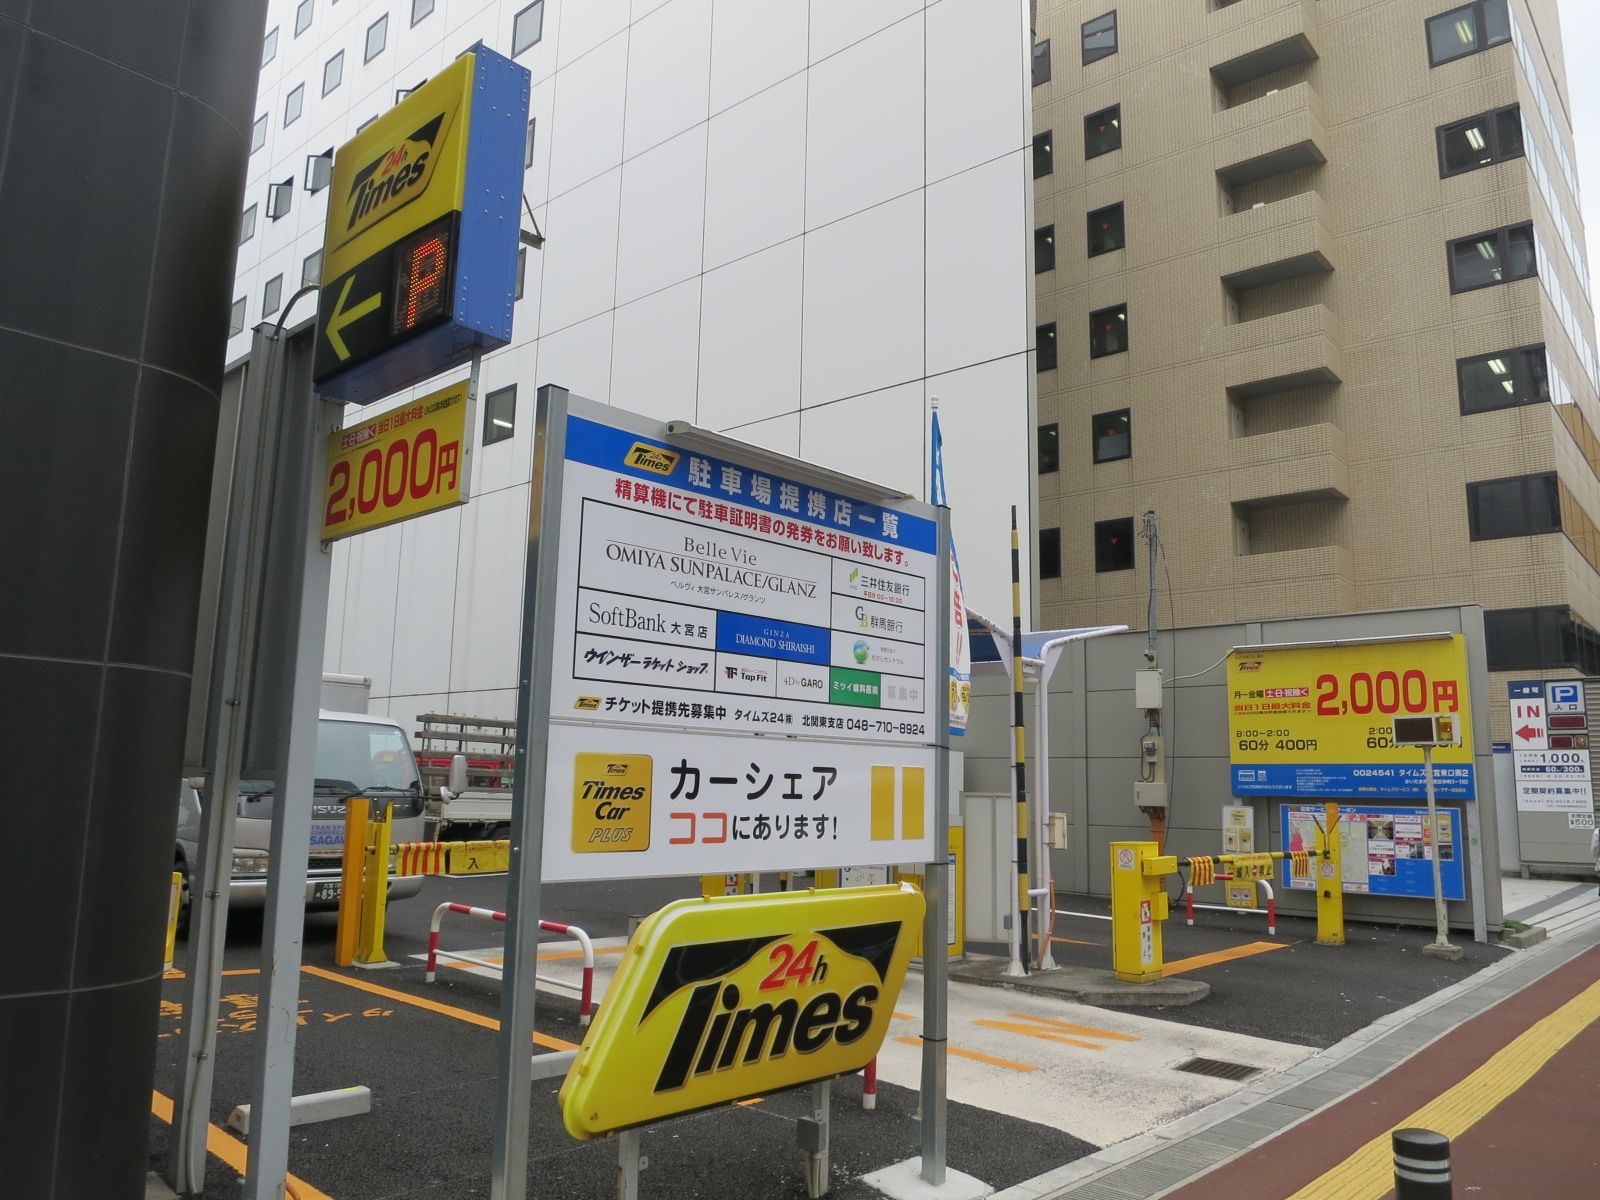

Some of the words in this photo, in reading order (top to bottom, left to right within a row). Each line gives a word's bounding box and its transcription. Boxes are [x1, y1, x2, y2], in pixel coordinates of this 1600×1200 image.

[346, 151, 429, 231] Times
[406, 237, 446, 330] P
[634, 453, 670, 471] Times
[325, 428, 459, 527] 2,000円
[688, 456, 898, 539] 駐車場提携店一覧
[615, 478, 909, 567] 精算機にて駐車証明書の発券をお願い致します。
[684, 537, 727, 560] Belle
[731, 547, 757, 566] Vie
[606, 543, 666, 571] OMIYA
[670, 556, 817, 599] SUNPALACE/GLANZ
[861, 575, 910, 596] 三井住友銀行
[589, 602, 667, 633] SoftBank
[670, 621, 708, 638] 大宮店
[870, 615, 903, 633] 群馬銀行
[735, 633, 777, 649] DIAMOND
[778, 641, 815, 654] SHIRAISHI
[763, 628, 791, 638] GINZA
[741, 672, 756, 682] Top
[757, 674, 768, 683] Fit
[801, 678, 824, 689] GARO
[1316, 669, 1459, 716] 2,000円
[605, 697, 727, 720] チケット提携先募集中
[802, 714, 844, 729] 北関東支店
[846, 718, 925, 735] 048-710-8924
[1517, 705, 1540, 718] IN
[1239, 739, 1269, 751] 60分
[1275, 739, 1318, 751] 400円
[670, 758, 837, 800] カーシェア
[582, 781, 645, 800] Times
[313, 805, 348, 814] ISUZ
[595, 801, 631, 820] Car
[588, 827, 633, 843] PLUS
[669, 812, 837, 845] ココにあります!
[467, 857, 480, 870] 入
[653, 980, 880, 1094] Times
